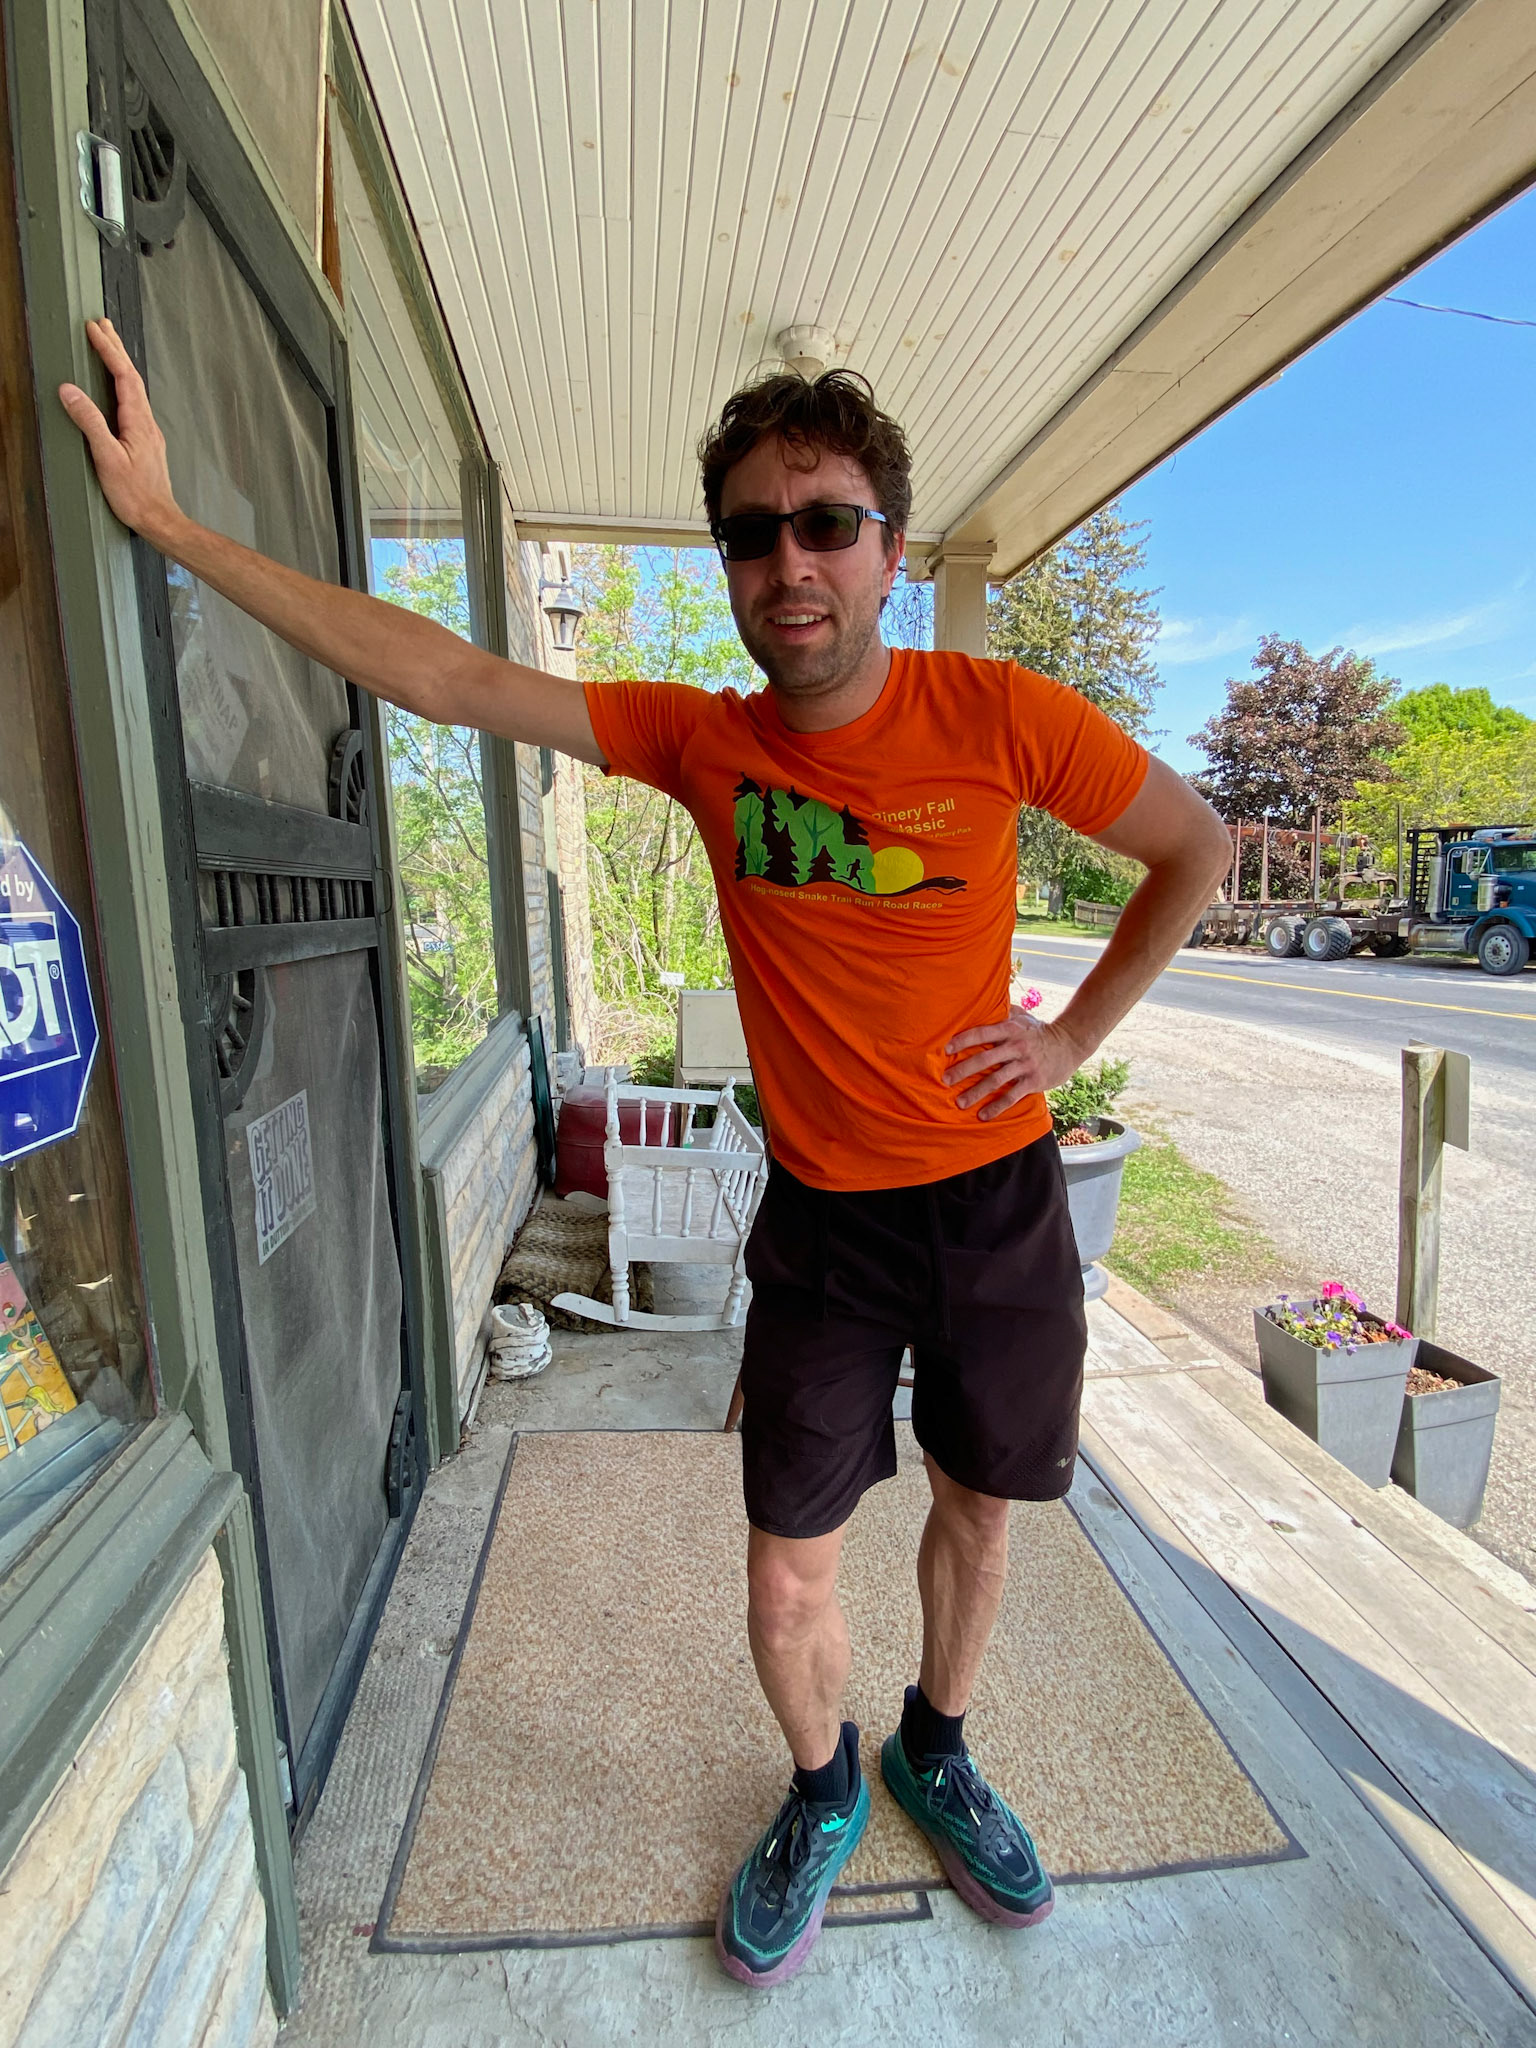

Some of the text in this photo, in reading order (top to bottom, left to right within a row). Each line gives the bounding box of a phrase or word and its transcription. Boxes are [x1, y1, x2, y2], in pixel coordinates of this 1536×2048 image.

[926, 798, 955, 815] Fall
[14, 873, 34, 903] by
[751, 883, 796, 899] Hog-nosed
[798, 890, 828, 902] Snake
[831, 894, 852, 904] Trail
[854, 896, 874, 908] Run
[883, 900, 910, 910] Road
[912, 901, 943, 910] Races
[0, 939, 60, 1049] DT
[251, 1096, 305, 1186] GETTING
[258, 1176, 275, 1238] IT
[271, 1127, 312, 1223] DONE
